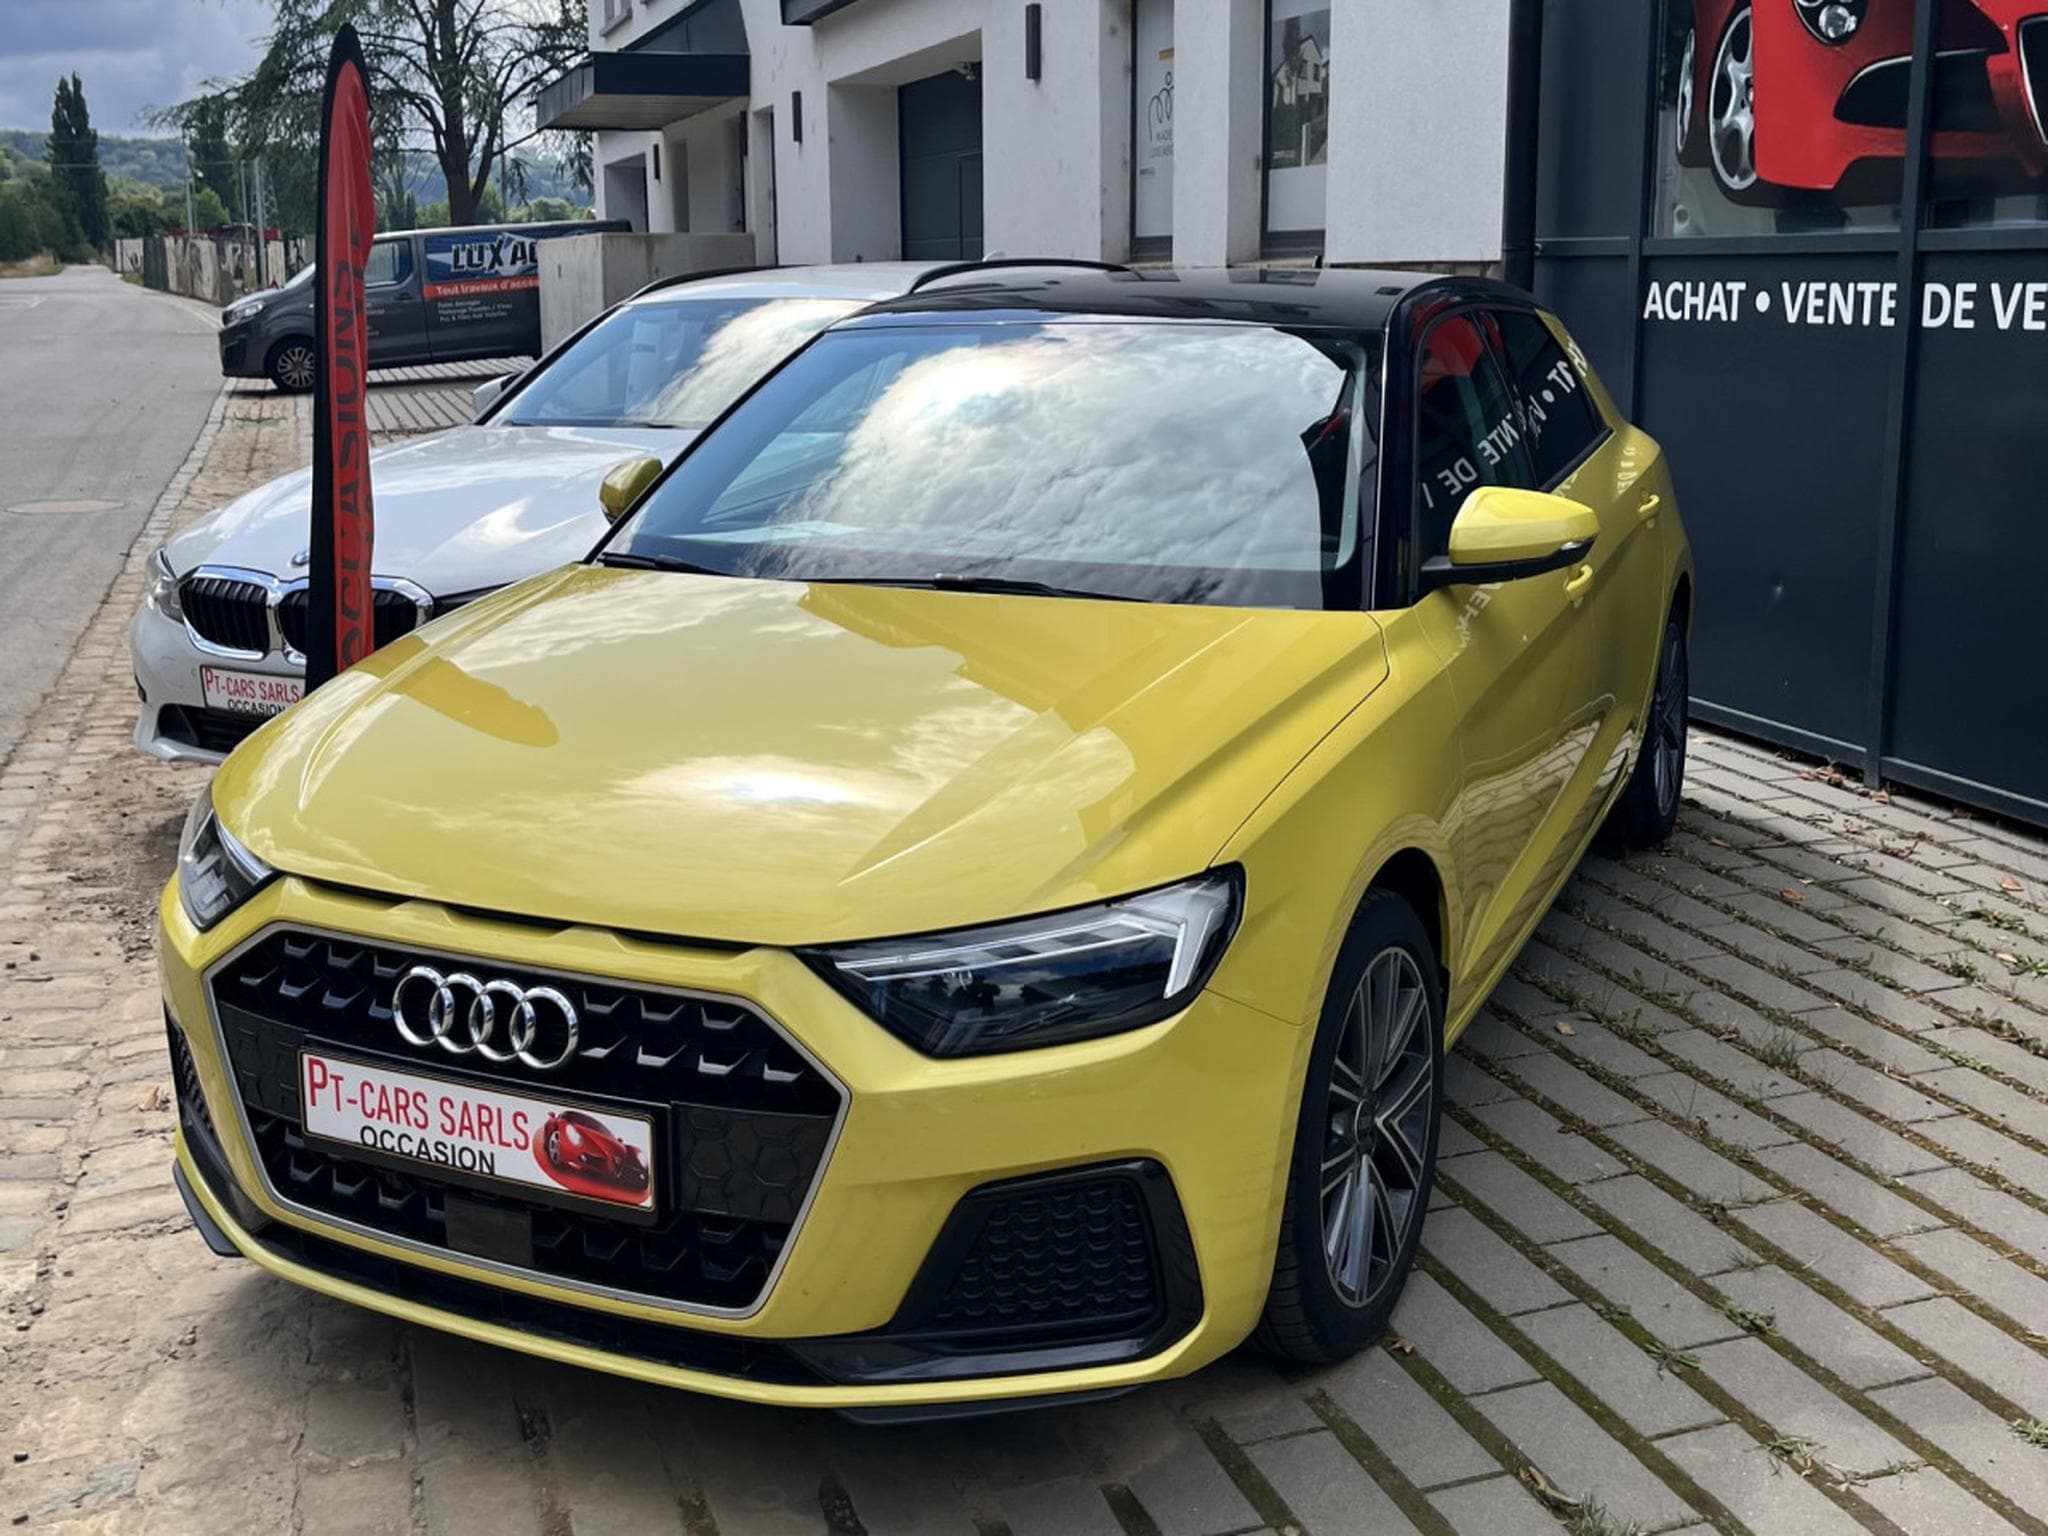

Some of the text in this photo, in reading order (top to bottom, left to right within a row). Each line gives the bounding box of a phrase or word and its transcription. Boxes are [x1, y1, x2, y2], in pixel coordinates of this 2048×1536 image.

[451, 235, 504, 273] LUX
[1643, 281, 2048, 330] ACHAT VENTE DE VE
[260, 681, 301, 704] SARLS
[439, 1096, 531, 1152] SARLS
[359, 1125, 497, 1175] OCCASION
